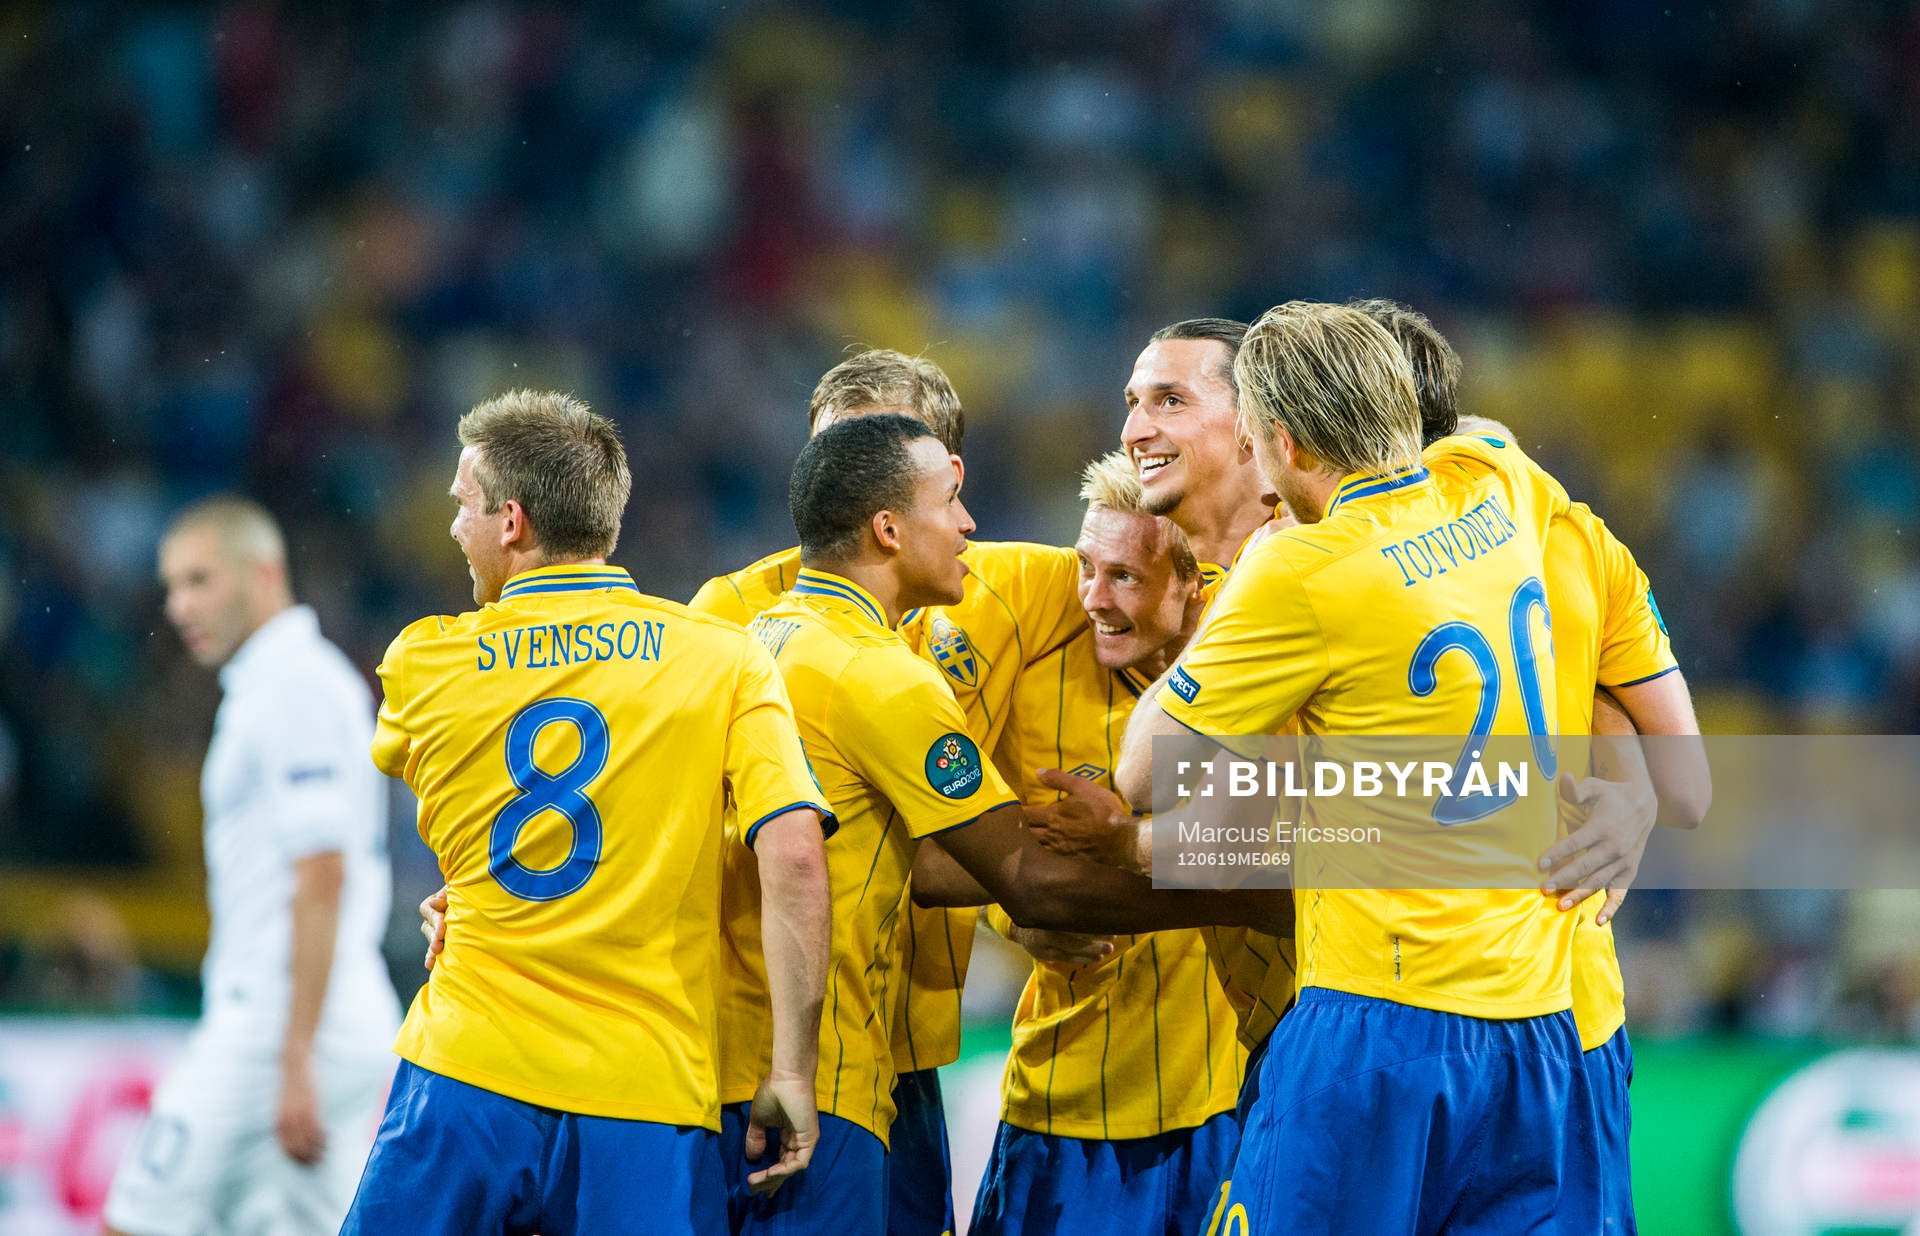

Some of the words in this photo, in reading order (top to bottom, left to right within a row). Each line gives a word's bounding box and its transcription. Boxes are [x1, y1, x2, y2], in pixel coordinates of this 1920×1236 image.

[1381, 495, 1518, 587] TOIVONEN
[477, 620, 665, 671] SVENSSON
[1408, 575, 1559, 826] 20
[488, 697, 611, 902] 8
